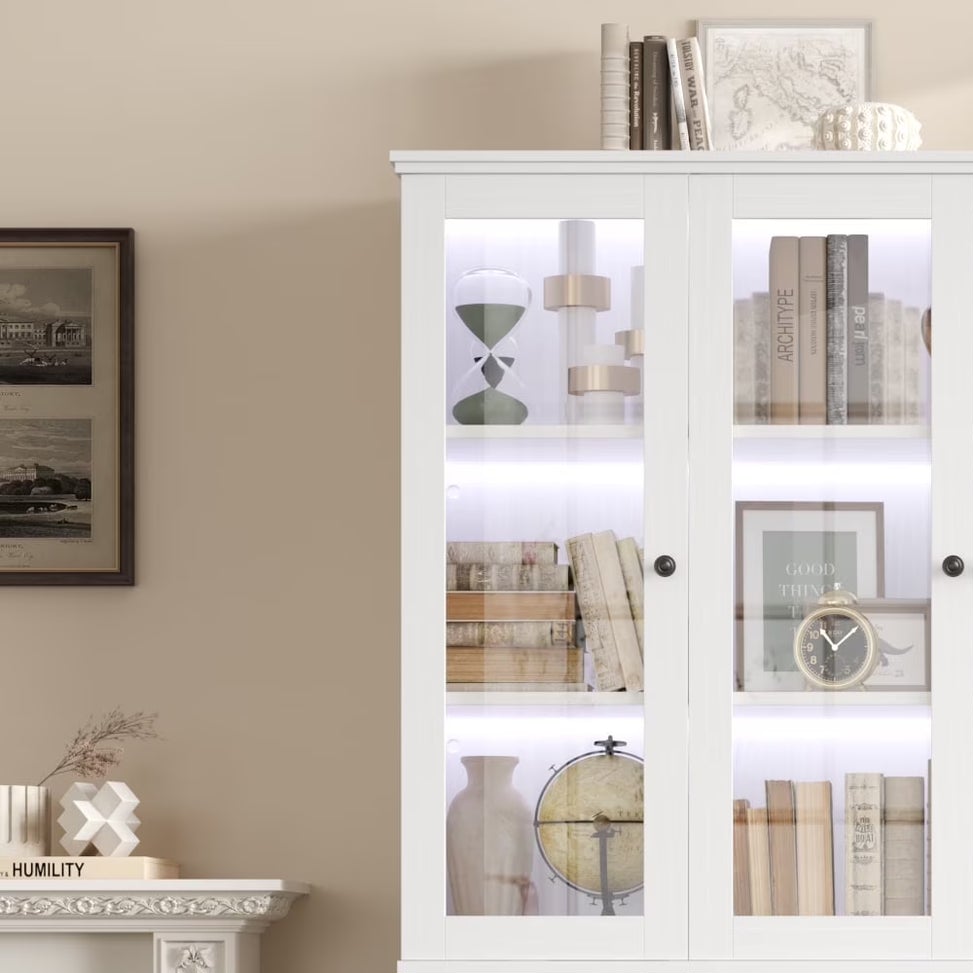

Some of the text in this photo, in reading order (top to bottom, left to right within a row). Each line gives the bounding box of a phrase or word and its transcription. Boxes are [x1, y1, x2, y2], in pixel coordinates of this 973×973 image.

[681, 40, 705, 150] TOLSTOY WAR PEAC
[777, 289, 794, 362] ARCHITYPE
[852, 306, 868, 340] pearl
[785, 562, 835, 576] GOOD
[809, 630, 819, 640] 10
[806, 643, 814, 652] 9
[810, 655, 817, 665] 8
[12, 862, 85, 877] HUMILITY
